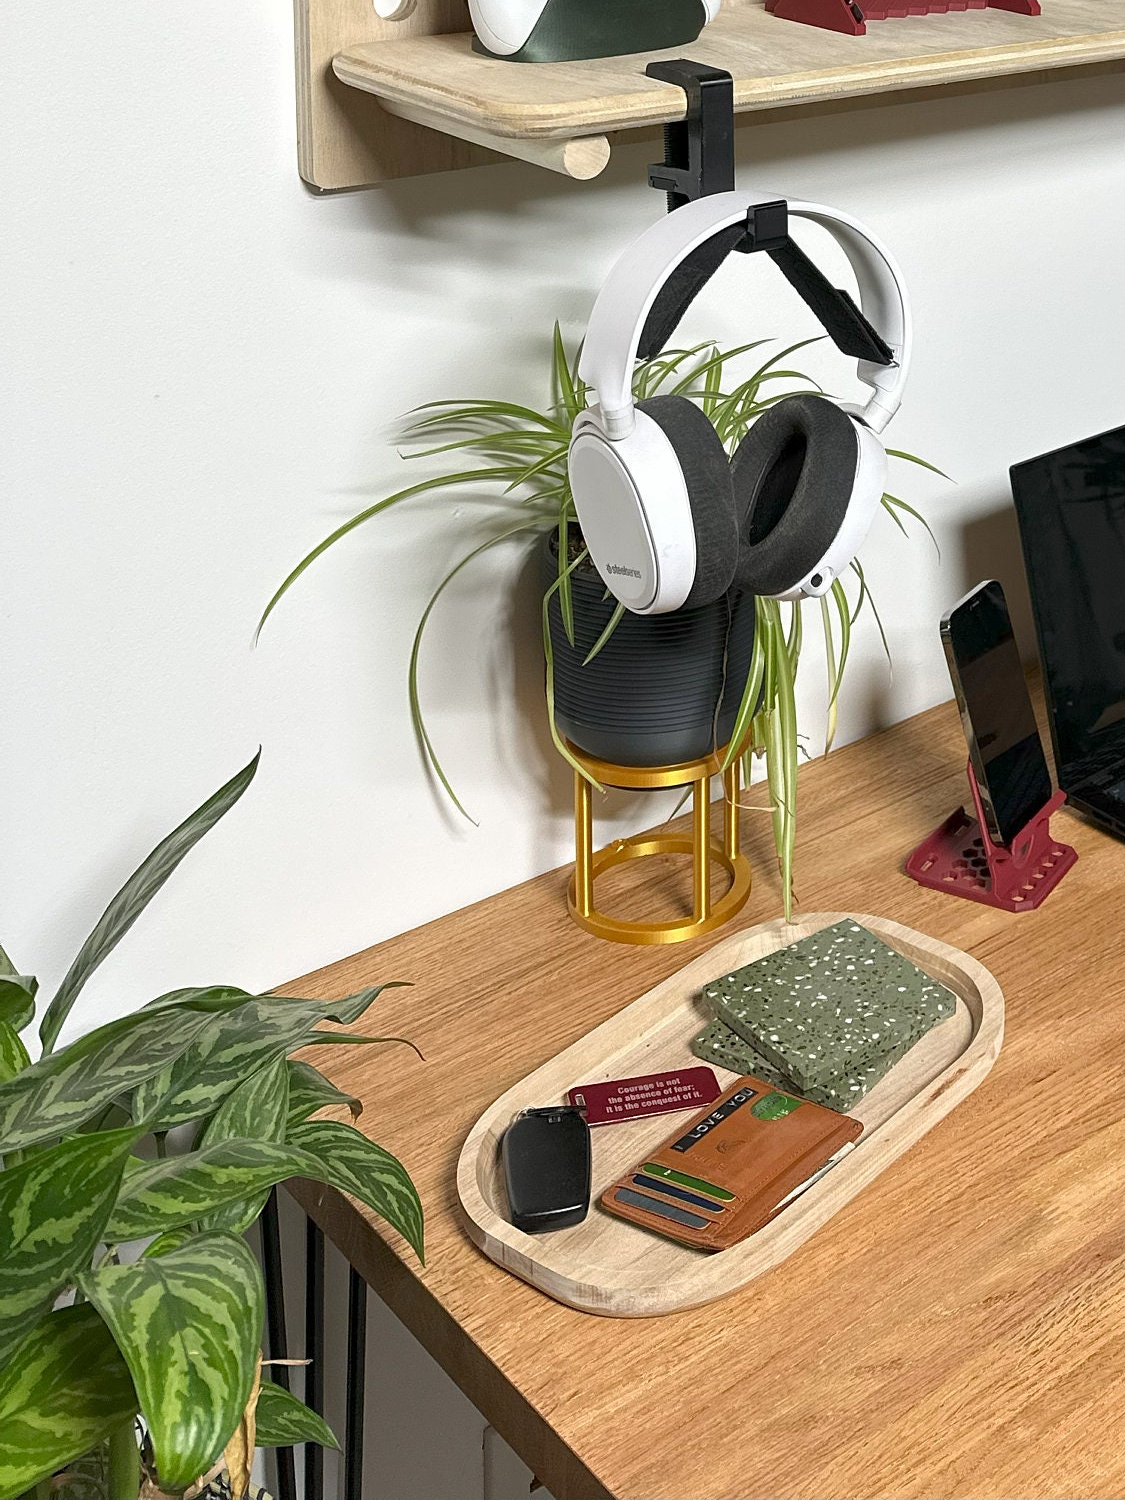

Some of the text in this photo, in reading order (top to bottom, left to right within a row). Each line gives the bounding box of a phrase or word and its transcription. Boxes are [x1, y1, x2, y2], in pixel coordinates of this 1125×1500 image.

[607, 1095, 622, 1105] the
[624, 1090, 662, 1103] absence
[663, 1086, 673, 1096] of
[617, 1082, 655, 1095] Courage
[666, 1077, 681, 1086] not
[624, 1102, 640, 1111] the
[641, 1095, 682, 1108] conquest
[683, 1091, 693, 1100] of
[690, 1111, 725, 1139] LOVE
[727, 1088, 754, 1107] YOU
